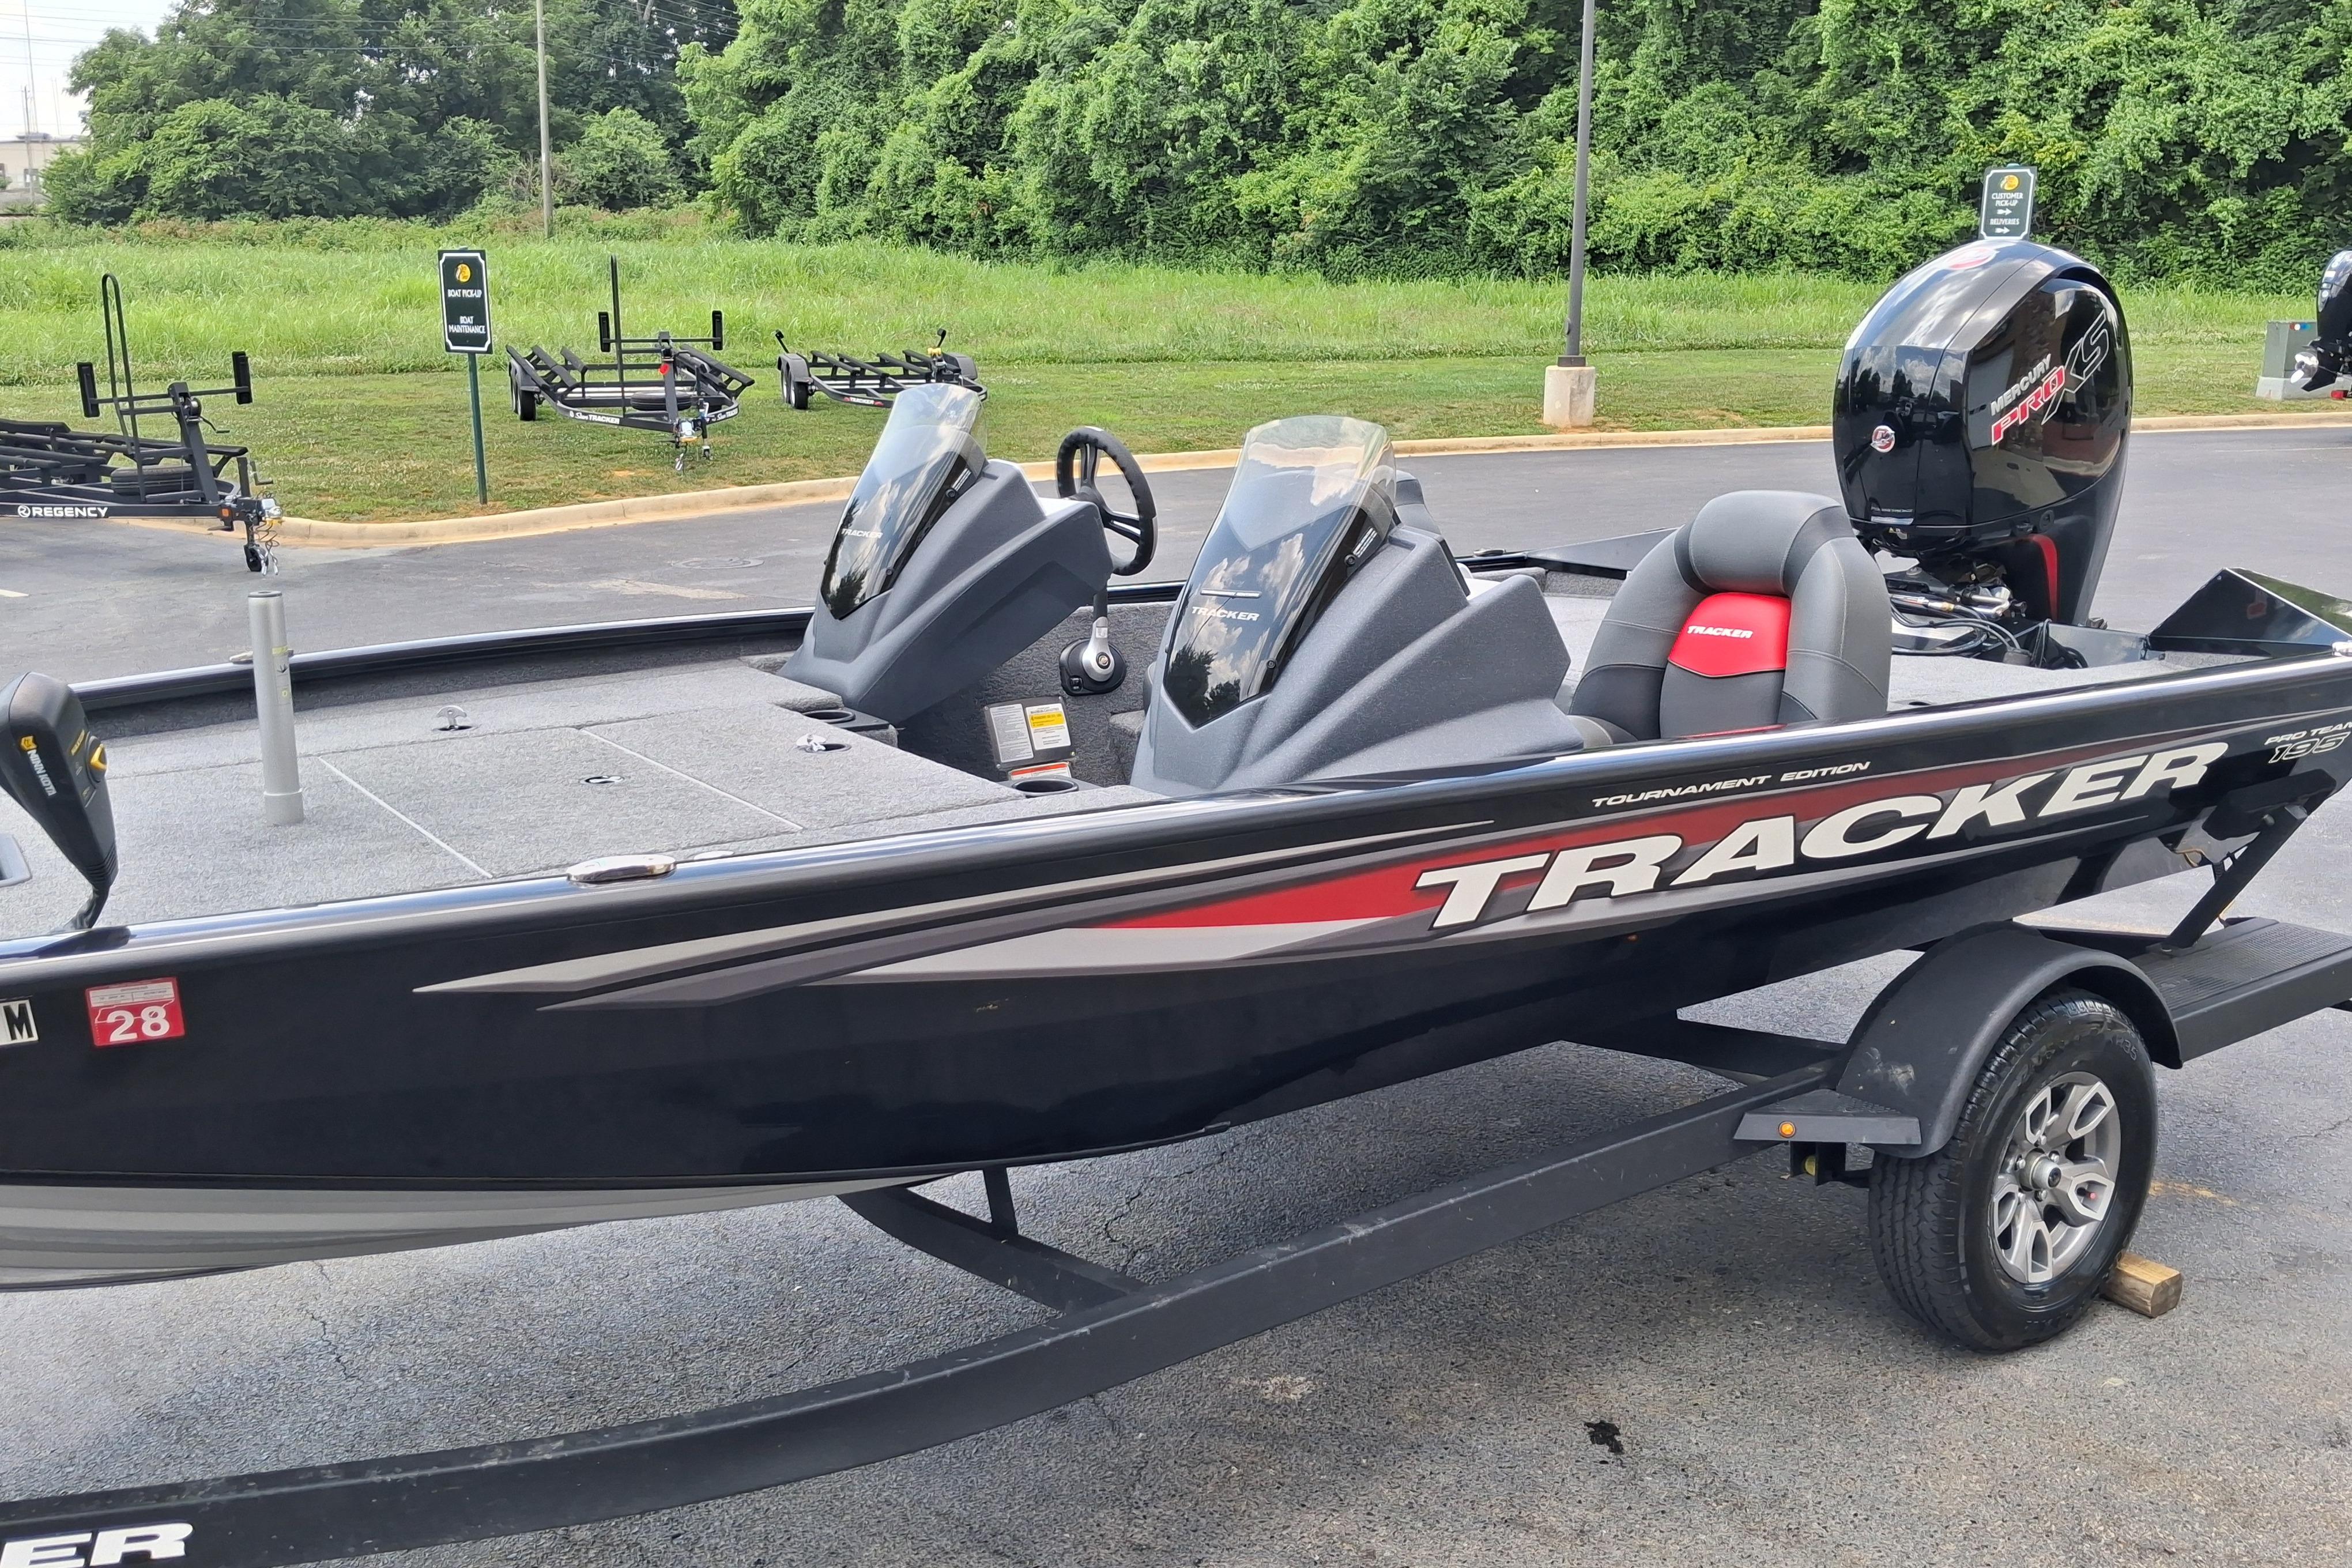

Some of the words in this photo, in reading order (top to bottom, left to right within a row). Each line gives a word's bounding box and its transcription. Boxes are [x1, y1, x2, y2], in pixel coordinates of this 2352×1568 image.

[447, 289, 461, 297] BOAT
[462, 289, 482, 297] PICK-UP
[459, 315, 474, 324] BOAT
[448, 325, 486, 334] MAINTENANCE
[1991, 353, 2052, 416] MERCURY
[1991, 365, 2065, 446] PRO
[588, 414, 620, 424] TRACKER
[32, 507, 108, 518] REGENCY
[841, 527, 884, 539] TRACKER
[1192, 606, 1260, 621] TRACKER
[1687, 625, 1753, 639] TRACKER
[2264, 730, 2307, 745] PRO
[27, 749, 47, 775] MINN
[38, 773, 58, 797] KOTA
[1592, 775, 1771, 808] TOURNAMENT
[1780, 761, 1871, 782] EDITION
[1414, 741, 2230, 928] TRACKER
[107, 1005, 170, 1042] 28
